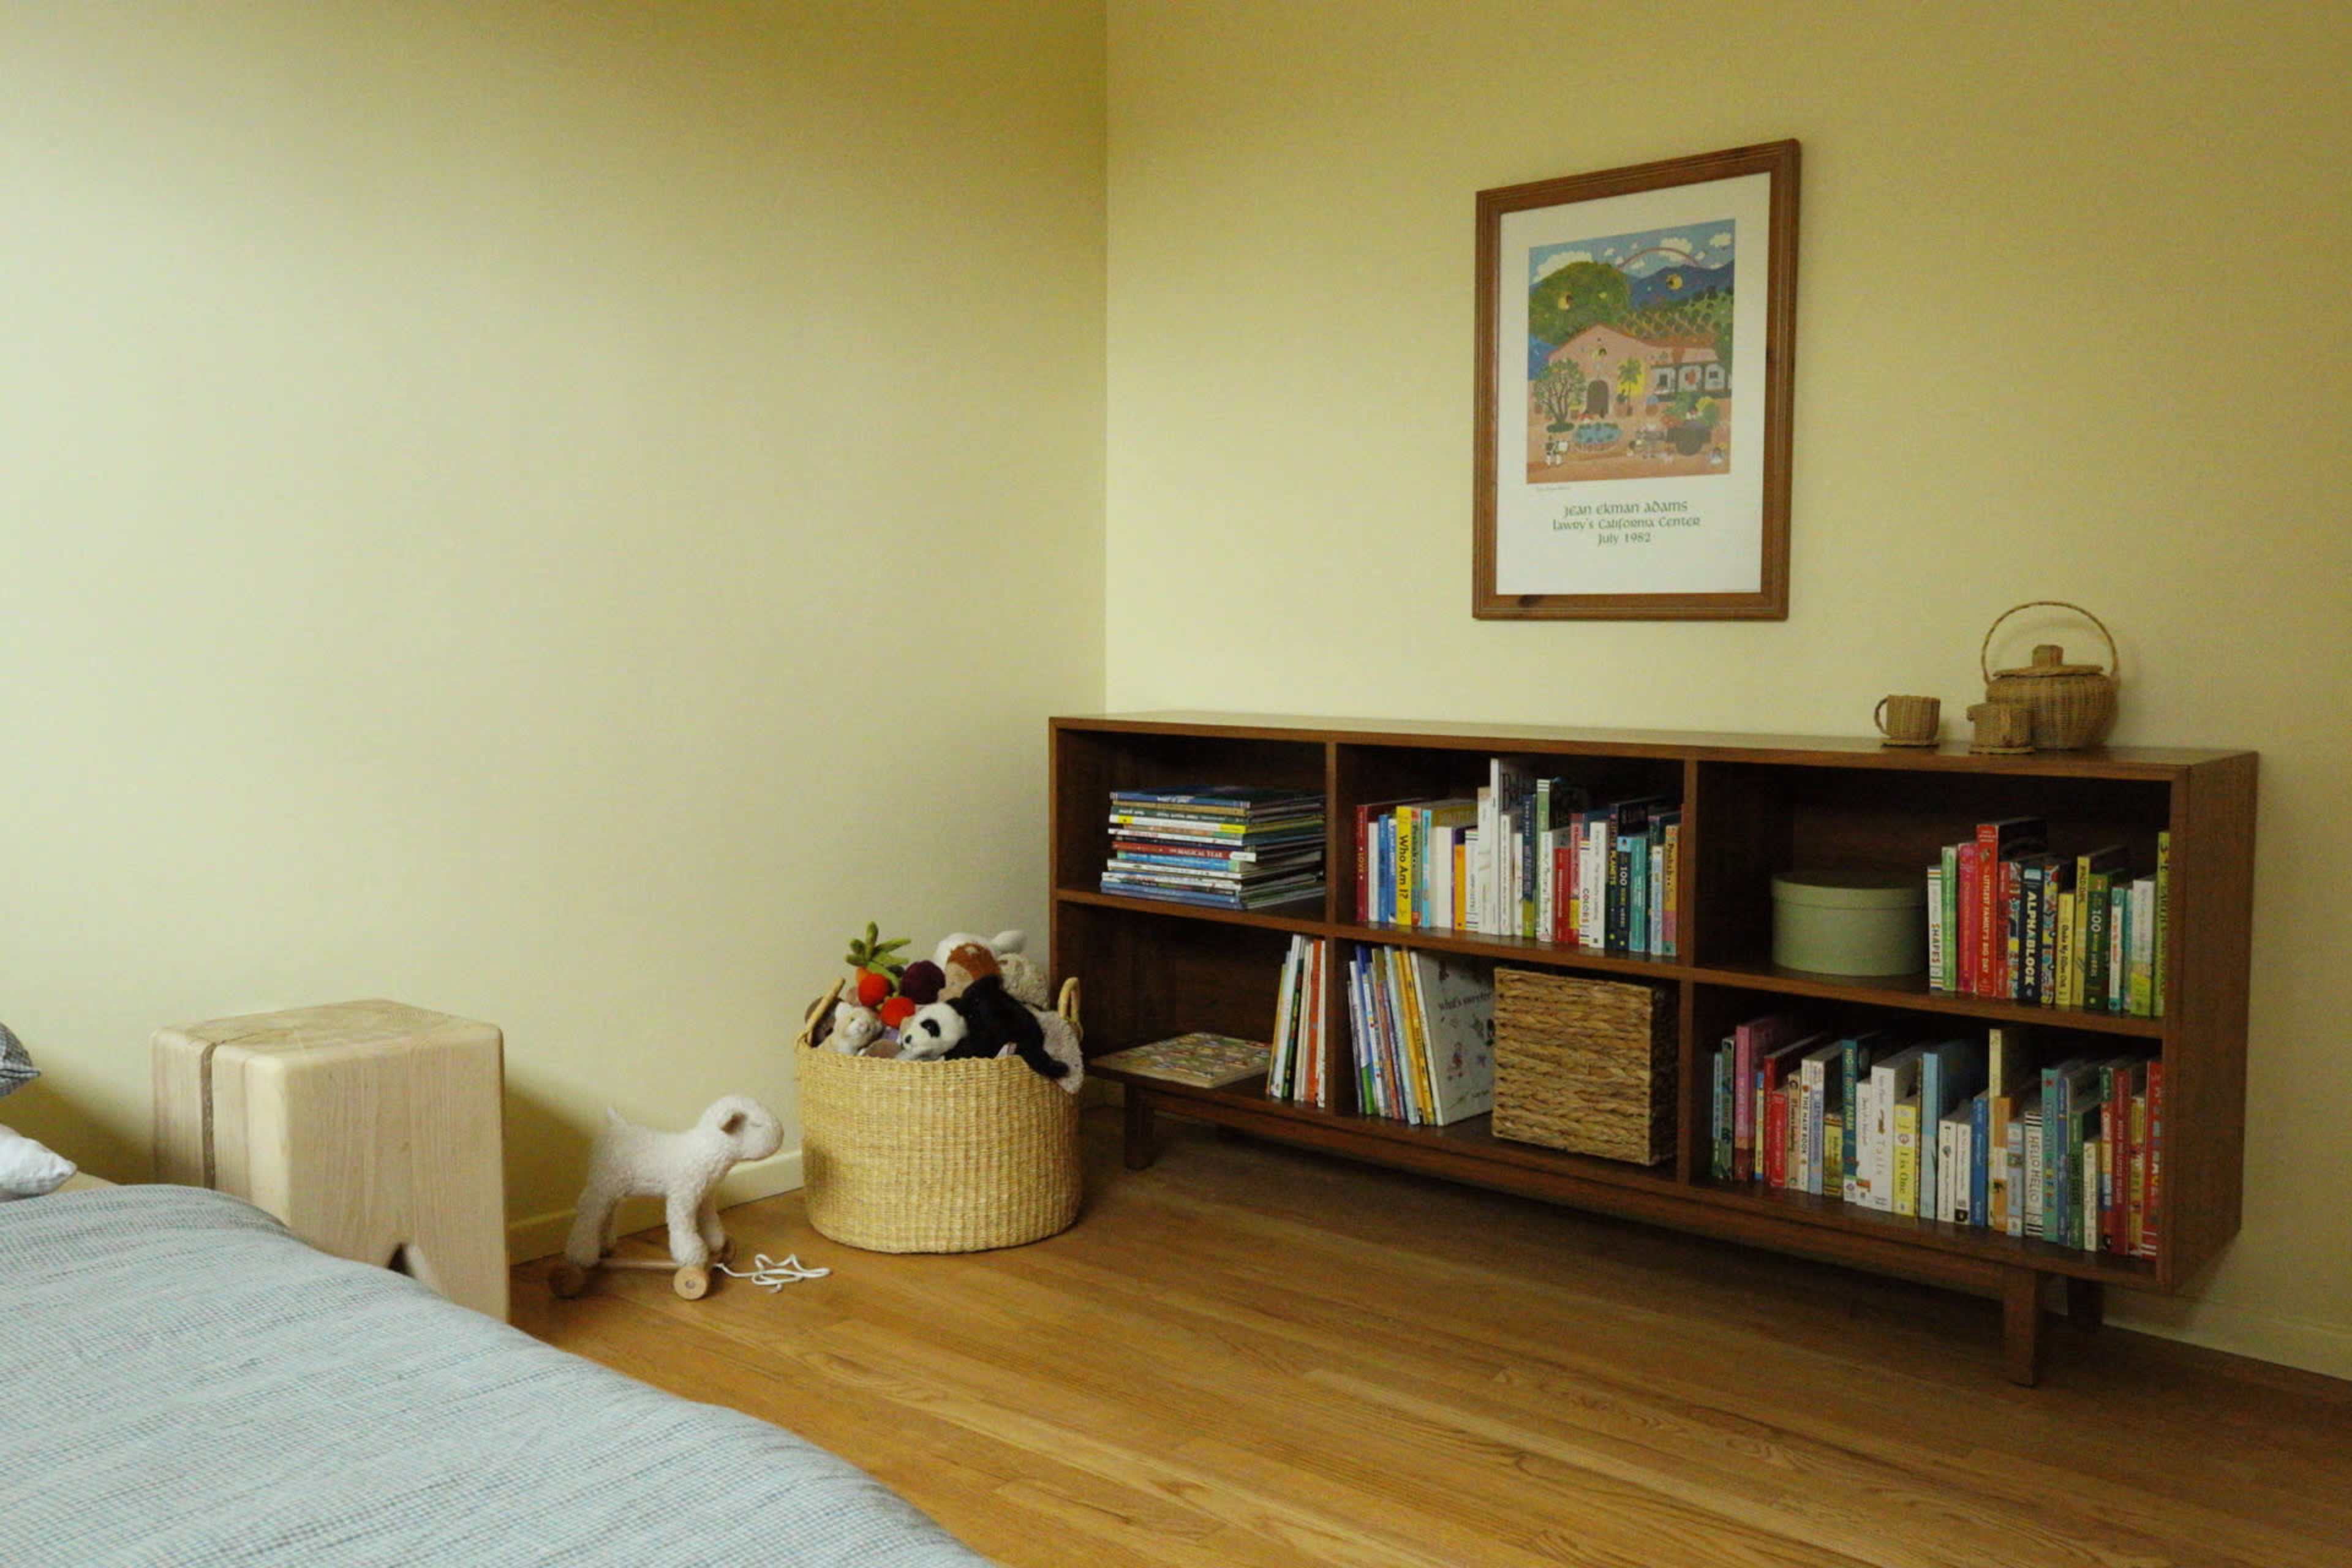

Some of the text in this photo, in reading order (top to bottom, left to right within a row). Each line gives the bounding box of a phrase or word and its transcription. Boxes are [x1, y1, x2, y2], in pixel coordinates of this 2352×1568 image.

[1658, 515, 1701, 527] Center
[1597, 532, 1651, 546] July 1982
[1178, 848, 1206, 857] MAGICAL
[1399, 834, 1409, 900] Who Am I?
[1619, 865, 1628, 886] 100
[2090, 909, 2101, 933] 100
[1932, 922, 1941, 964] SHAPES
[2025, 891, 2038, 986] ALPHABLOCK
[1845, 1105, 1854, 1131] FARM
[2029, 1136, 2040, 1204] HELLO HELLO
[1900, 1172, 1910, 1194] One
